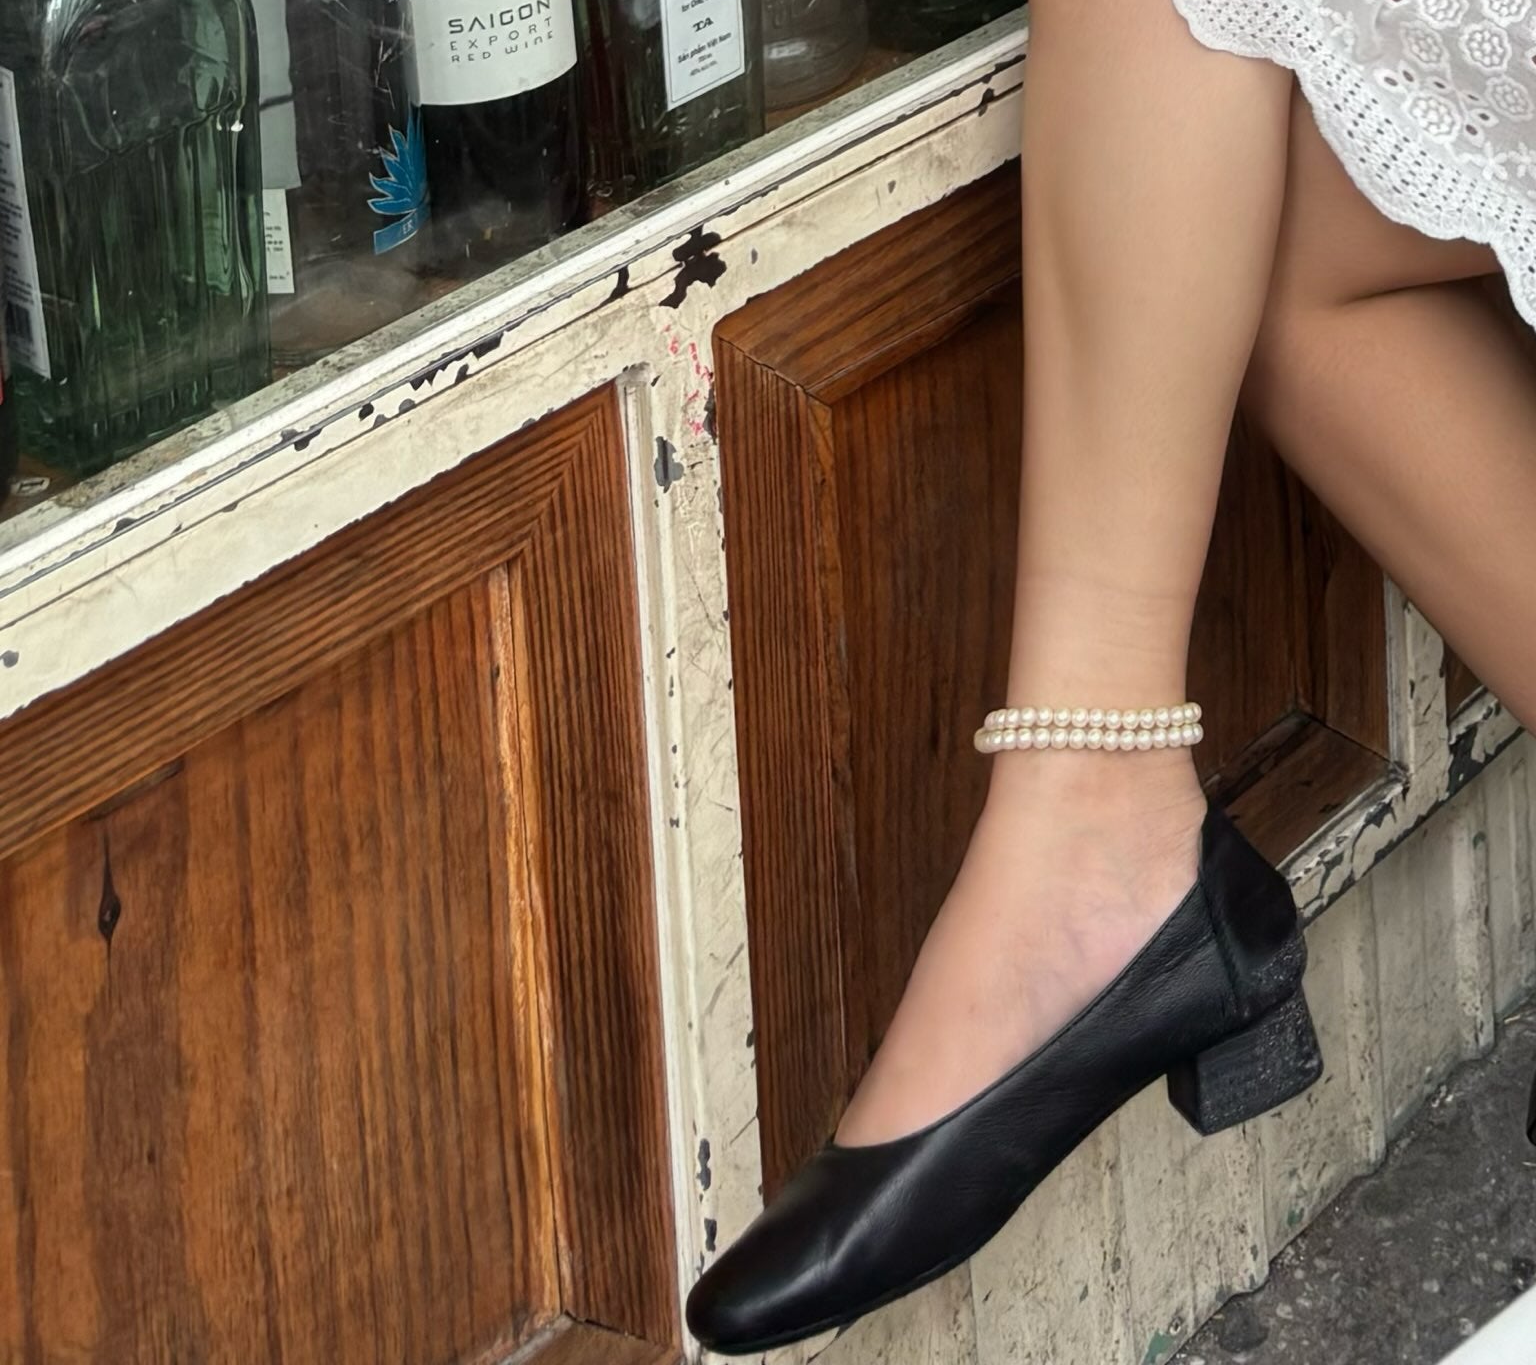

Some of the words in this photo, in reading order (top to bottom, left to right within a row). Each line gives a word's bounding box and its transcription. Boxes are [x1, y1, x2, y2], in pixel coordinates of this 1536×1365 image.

[692, 17, 714, 33] TA
[450, 17, 553, 51] EXPORT
[451, 50, 492, 63] RED
